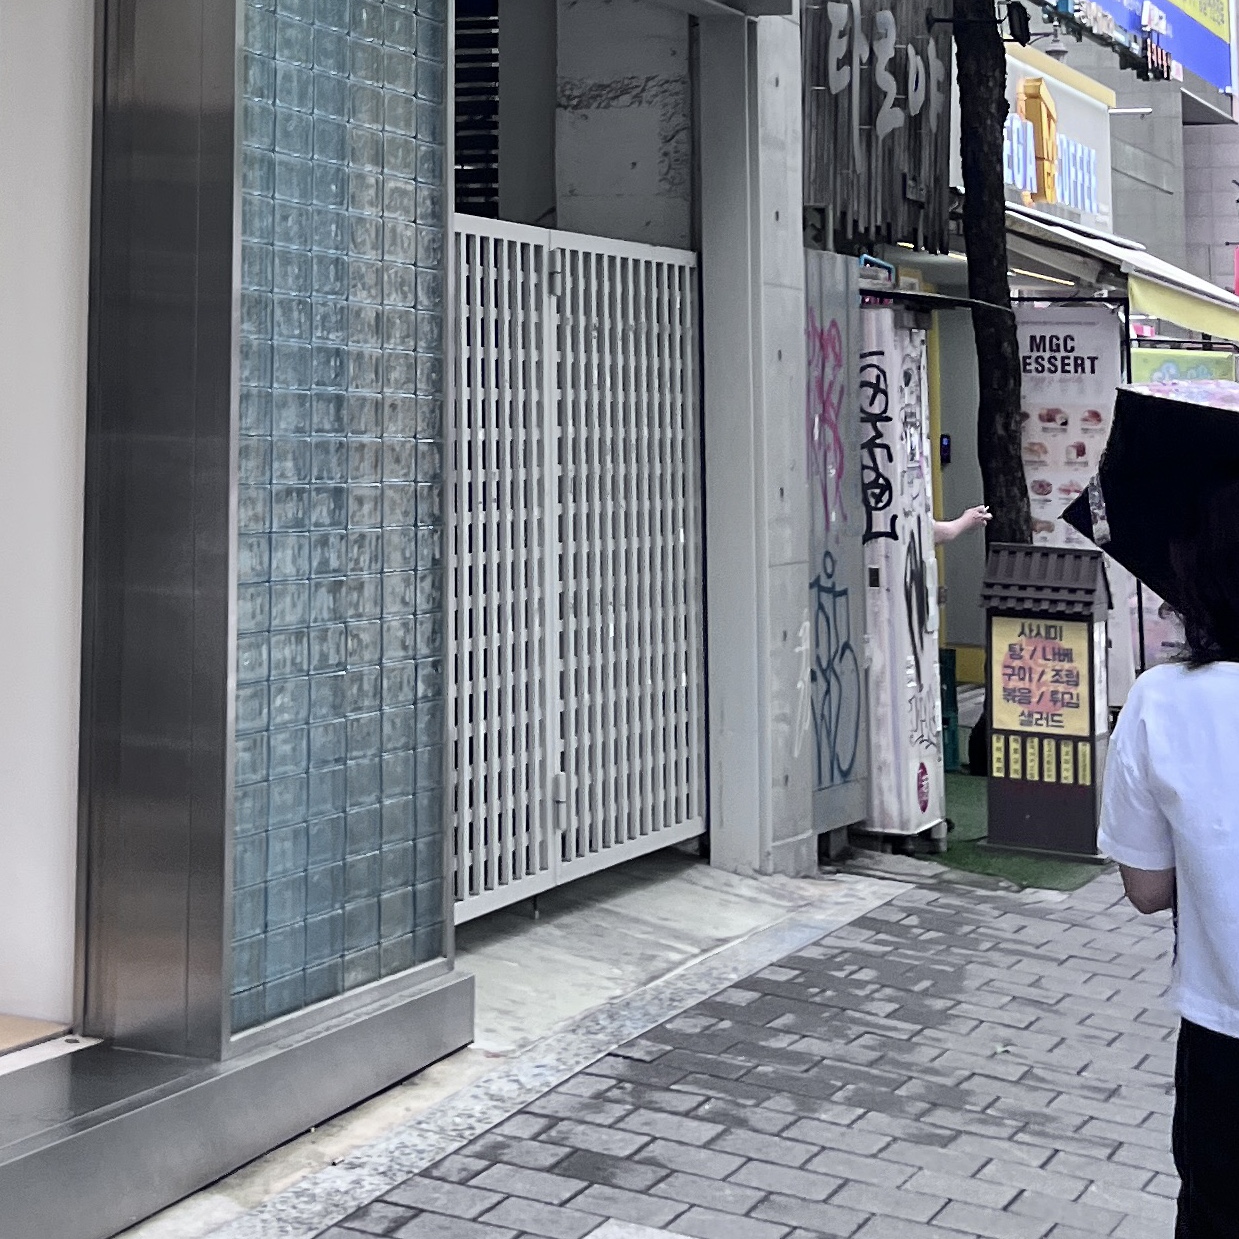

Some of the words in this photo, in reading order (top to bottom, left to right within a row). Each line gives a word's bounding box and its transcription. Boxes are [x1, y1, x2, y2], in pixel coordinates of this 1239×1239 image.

[1003, 113, 1037, 193] EGA
[1029, 334, 1075, 353] MGC
[1021, 355, 1099, 375] ESSERT
[1018, 622, 1063, 641] 사시미
[1008, 643, 1024, 661] 탕
[1042, 646, 1074, 663] 나베
[1002, 665, 1032, 682] 구이
[1050, 668, 1080, 686] 조림
[1002, 686, 1032, 706] 볶음
[1050, 690, 1080, 709] 튀김
[1019, 710, 1065, 728] 샐러드
